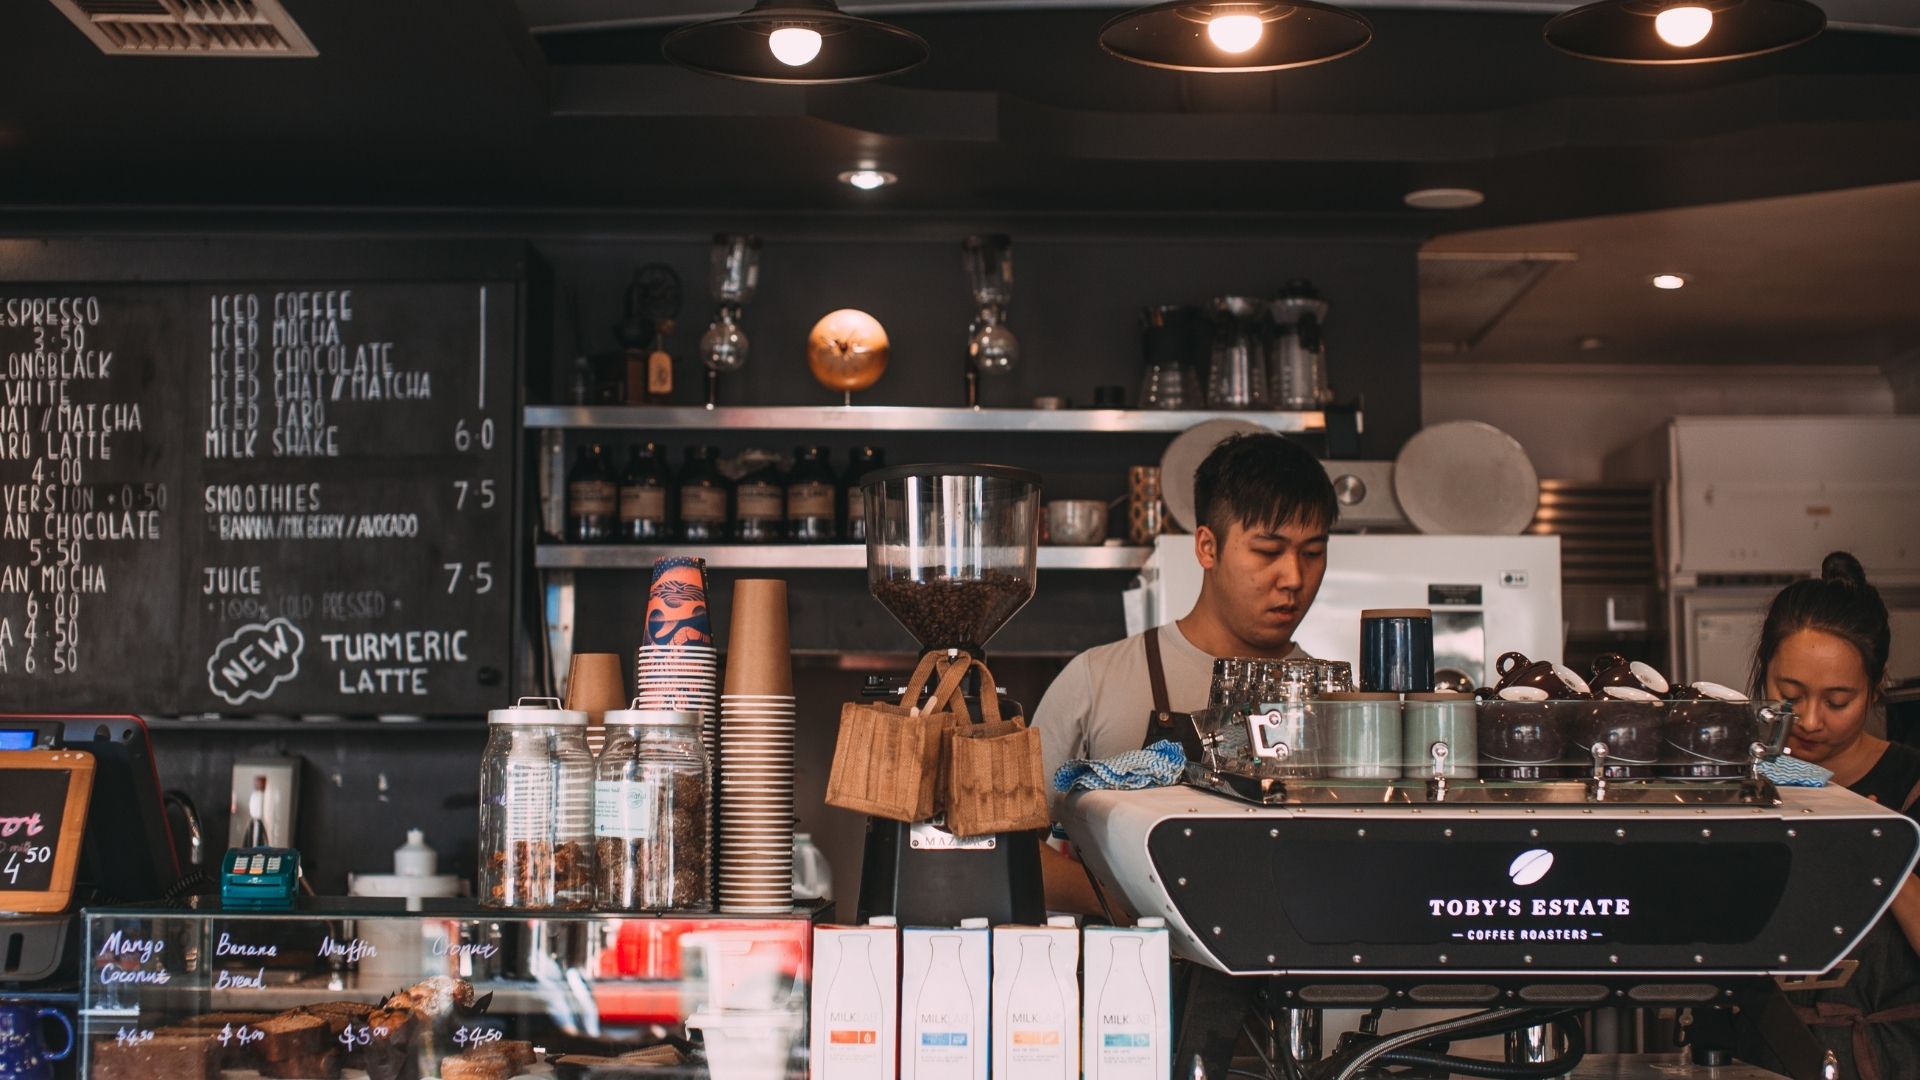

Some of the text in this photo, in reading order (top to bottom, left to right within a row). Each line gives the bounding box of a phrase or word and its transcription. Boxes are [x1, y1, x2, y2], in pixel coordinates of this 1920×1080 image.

[210, 290, 352, 322] ICED COFFEE
[210, 317, 341, 350] ICED MOCHA
[210, 341, 394, 377] ICED CHOCOLATE
[5, 381, 70, 406] WHITE
[210, 373, 260, 402] ICED
[210, 399, 325, 430] ICED TARO
[48, 430, 111, 460] LATTE
[205, 427, 257, 458] MILK
[271, 424, 339, 457] SHAKE
[4, 484, 94, 513] VERSION
[204, 482, 321, 513] SMOOTHIES
[44, 510, 160, 540] CHOCOLATE
[41, 564, 106, 593] MOCHA
[203, 565, 262, 595] JUICE
[221, 625, 289, 688] NEW
[320, 630, 468, 663] TURMERIC
[339, 667, 428, 695] LATTE
[1429, 899, 1630, 916] TOBY'S ESTATE
[100, 930, 164, 963] Mango
[216, 932, 277, 957] Banana
[318, 936, 377, 963] Muffin
[1467, 929, 1588, 941] COFFEE ROASTERS
[101, 962, 171, 985] Coconut
[215, 967, 266, 990] Bread
